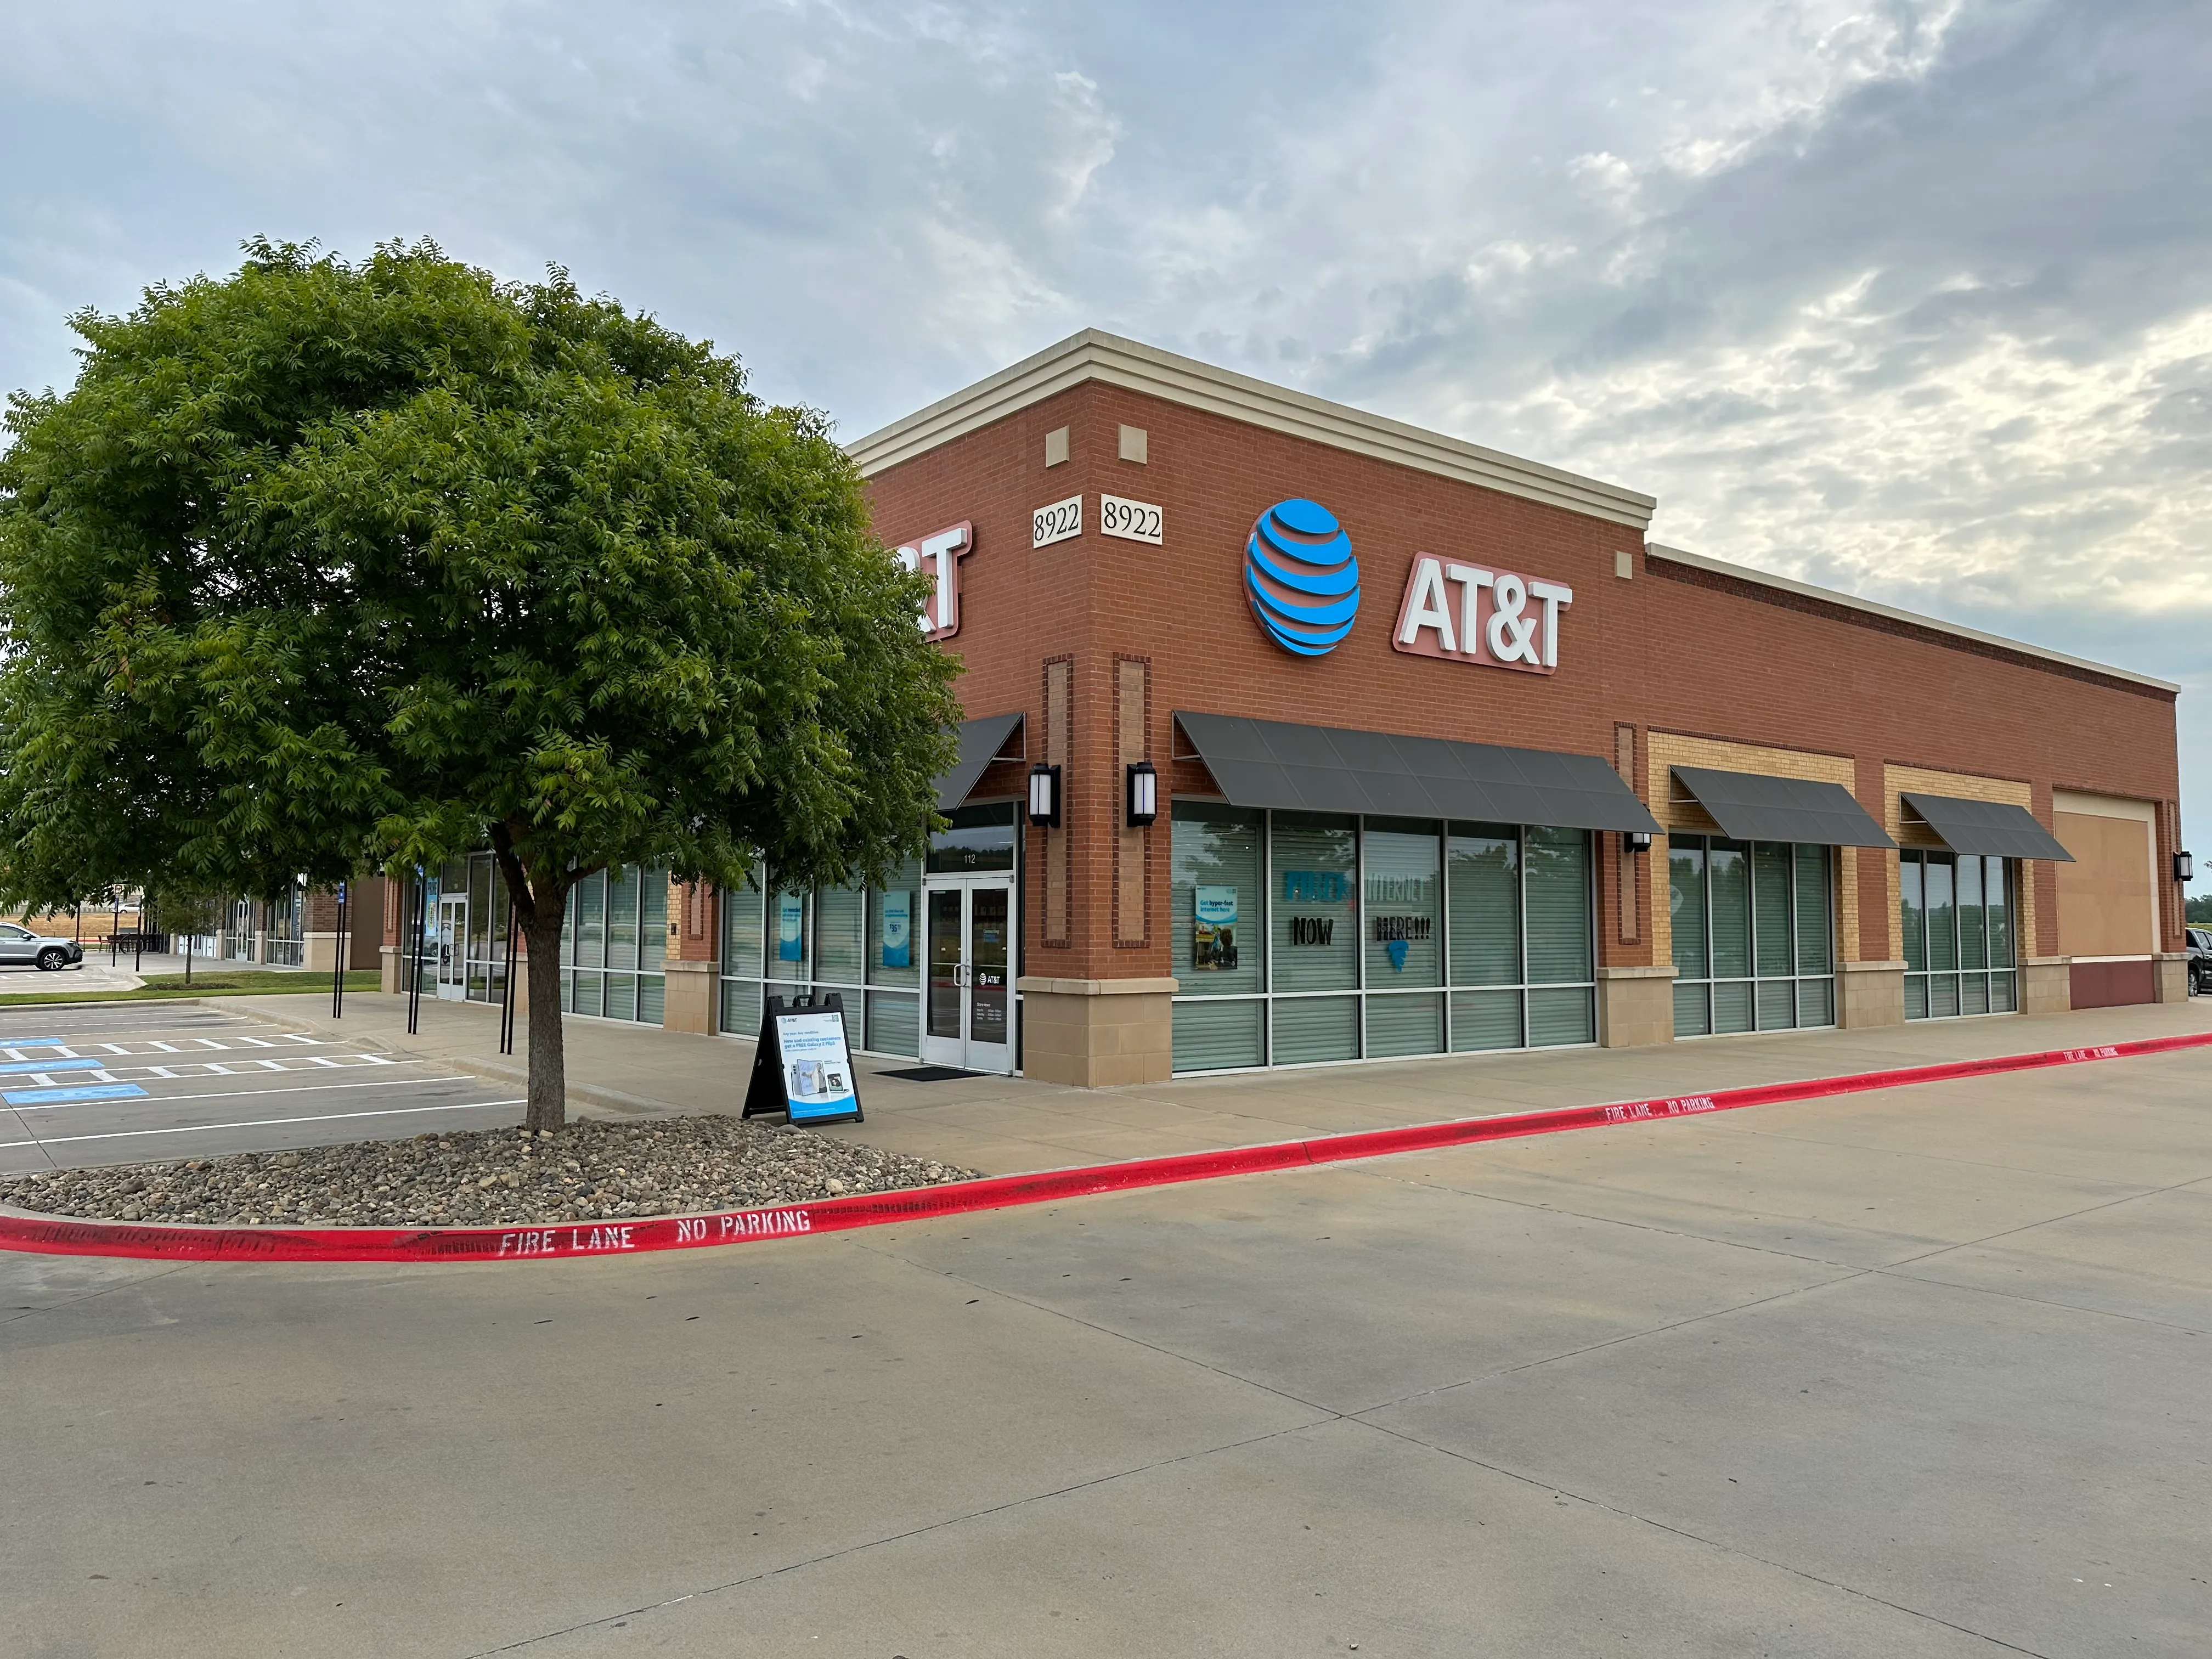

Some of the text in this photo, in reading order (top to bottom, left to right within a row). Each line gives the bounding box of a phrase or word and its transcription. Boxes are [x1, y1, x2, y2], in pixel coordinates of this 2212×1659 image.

[1034, 503, 1079, 542] 8922
[1104, 501, 1161, 538] 8922
[1398, 558, 1573, 668] AT&T
[964, 854, 975, 864] 112
[1293, 916, 1431, 946] NOW HERE!!!
[987, 975, 1000, 984] AT&T
[1605, 1097, 1716, 1121] FIRE LANE NO PARKING
[499, 1210, 811, 1256] FIRE LANE NO PARKING
